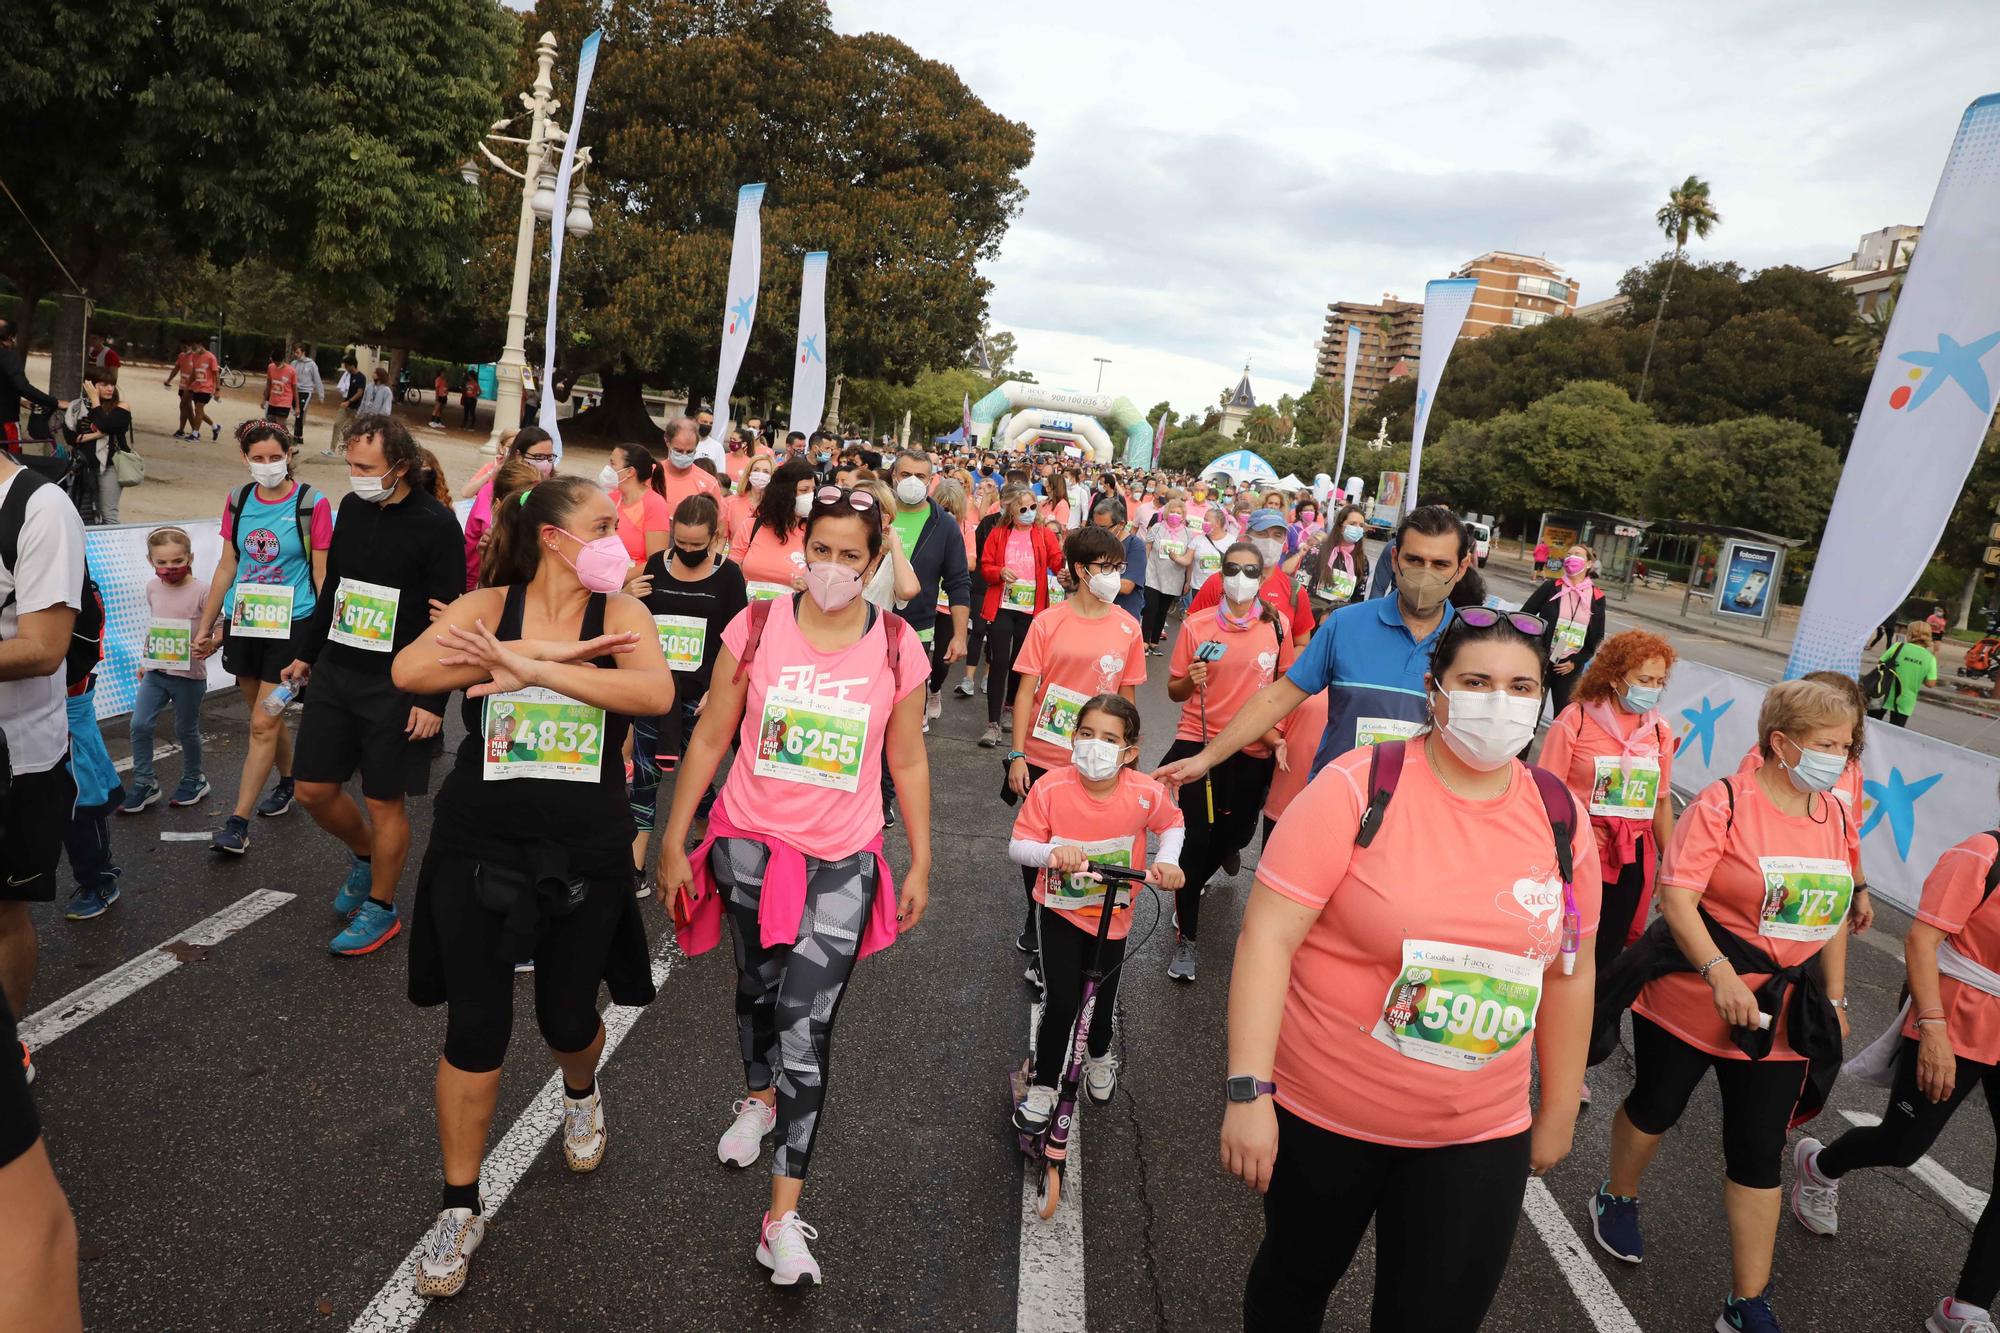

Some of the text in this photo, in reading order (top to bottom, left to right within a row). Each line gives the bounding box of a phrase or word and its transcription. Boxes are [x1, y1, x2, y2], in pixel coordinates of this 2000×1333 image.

[245, 603, 288, 623] 5686
[344, 604, 387, 633] 6174
[149, 636, 187, 656] 5693
[658, 634, 701, 656] 5030
[491, 741, 508, 749] MAR
[515, 720, 598, 754] 4832
[763, 740, 779, 749] MAR
[786, 725, 858, 765] 6255
[491, 748, 507, 757] CHA
[762, 747, 777, 757] CHA
[1050, 878, 1062, 886] MAR
[1797, 888, 1839, 917] 173
[1470, 959, 1495, 970] aecc
[1388, 1016, 1408, 1029] CHA
[1390, 1008, 1411, 1022] MAR
[1422, 987, 1526, 1044] 5909
